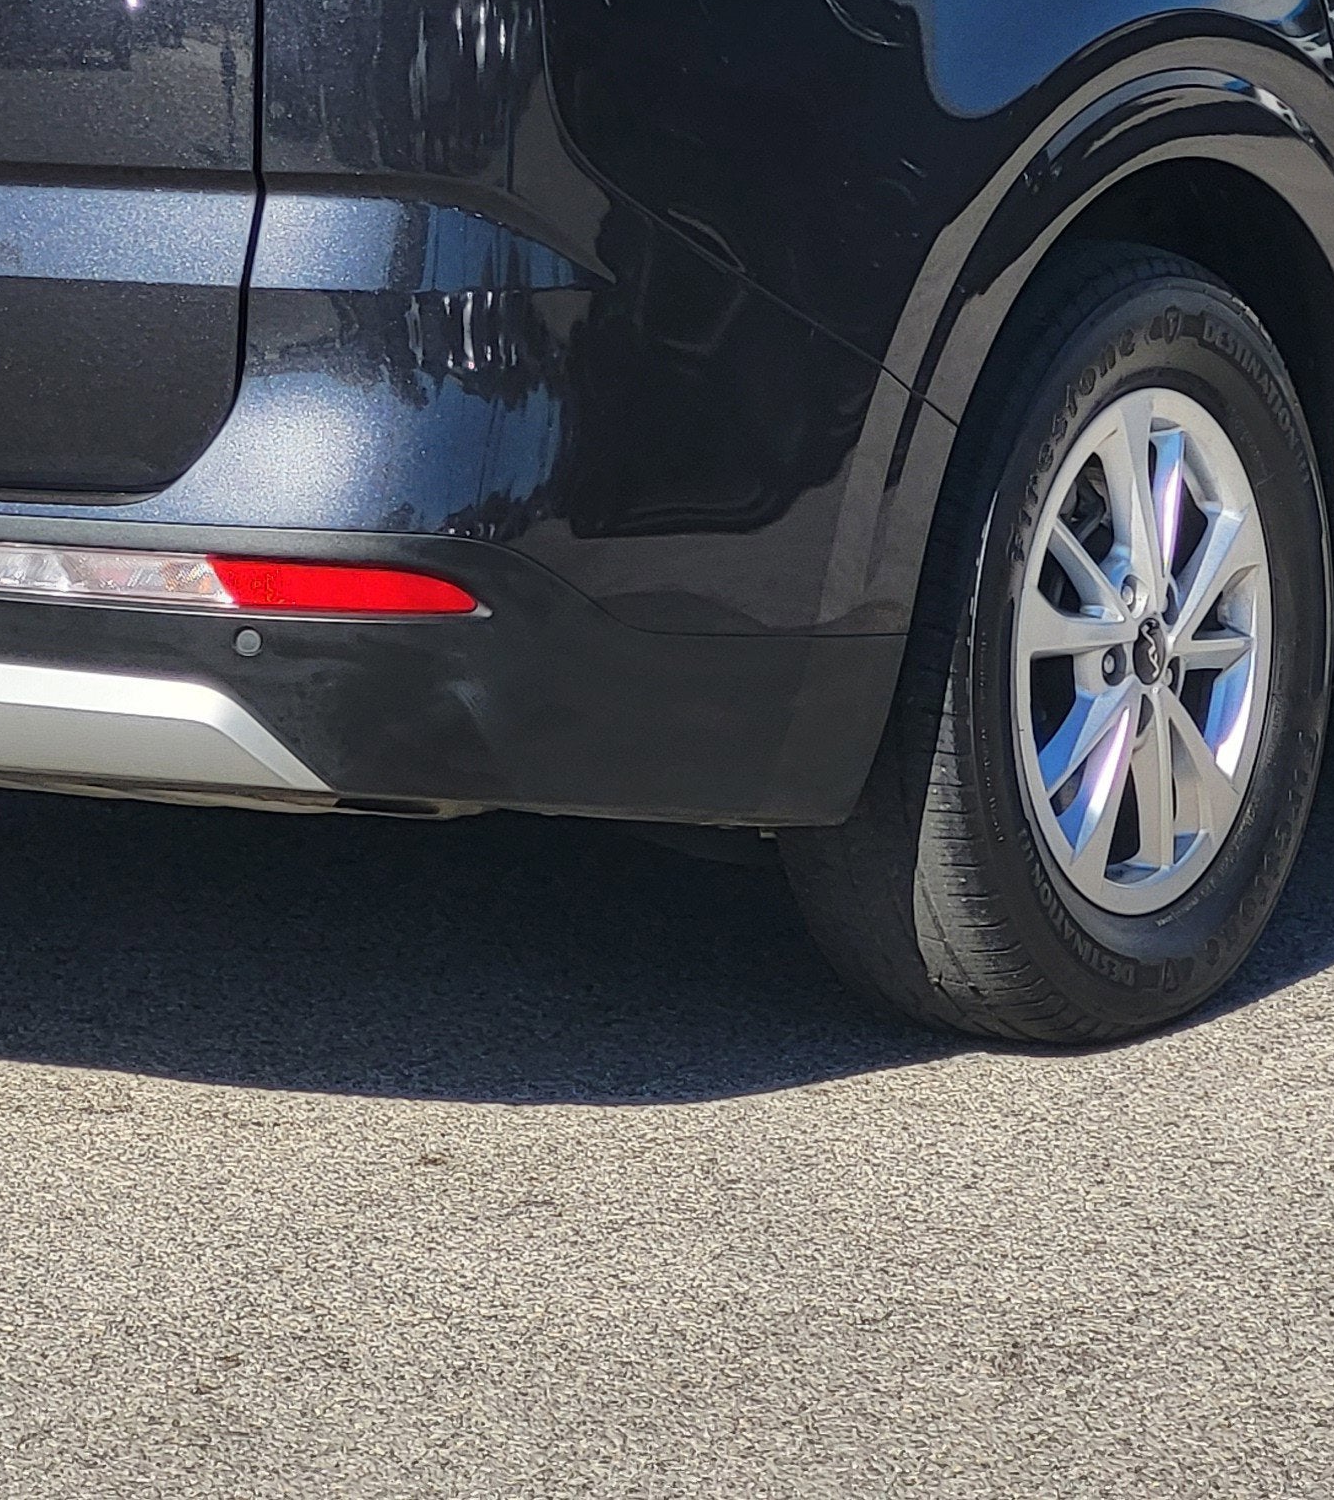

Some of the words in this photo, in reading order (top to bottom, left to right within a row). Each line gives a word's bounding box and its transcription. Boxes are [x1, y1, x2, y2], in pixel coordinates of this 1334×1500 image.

[1006, 327, 1136, 563] Firestone
[1202, 317, 1299, 451] DESTINATION
[1031, 862, 1136, 987] DESTINATION
